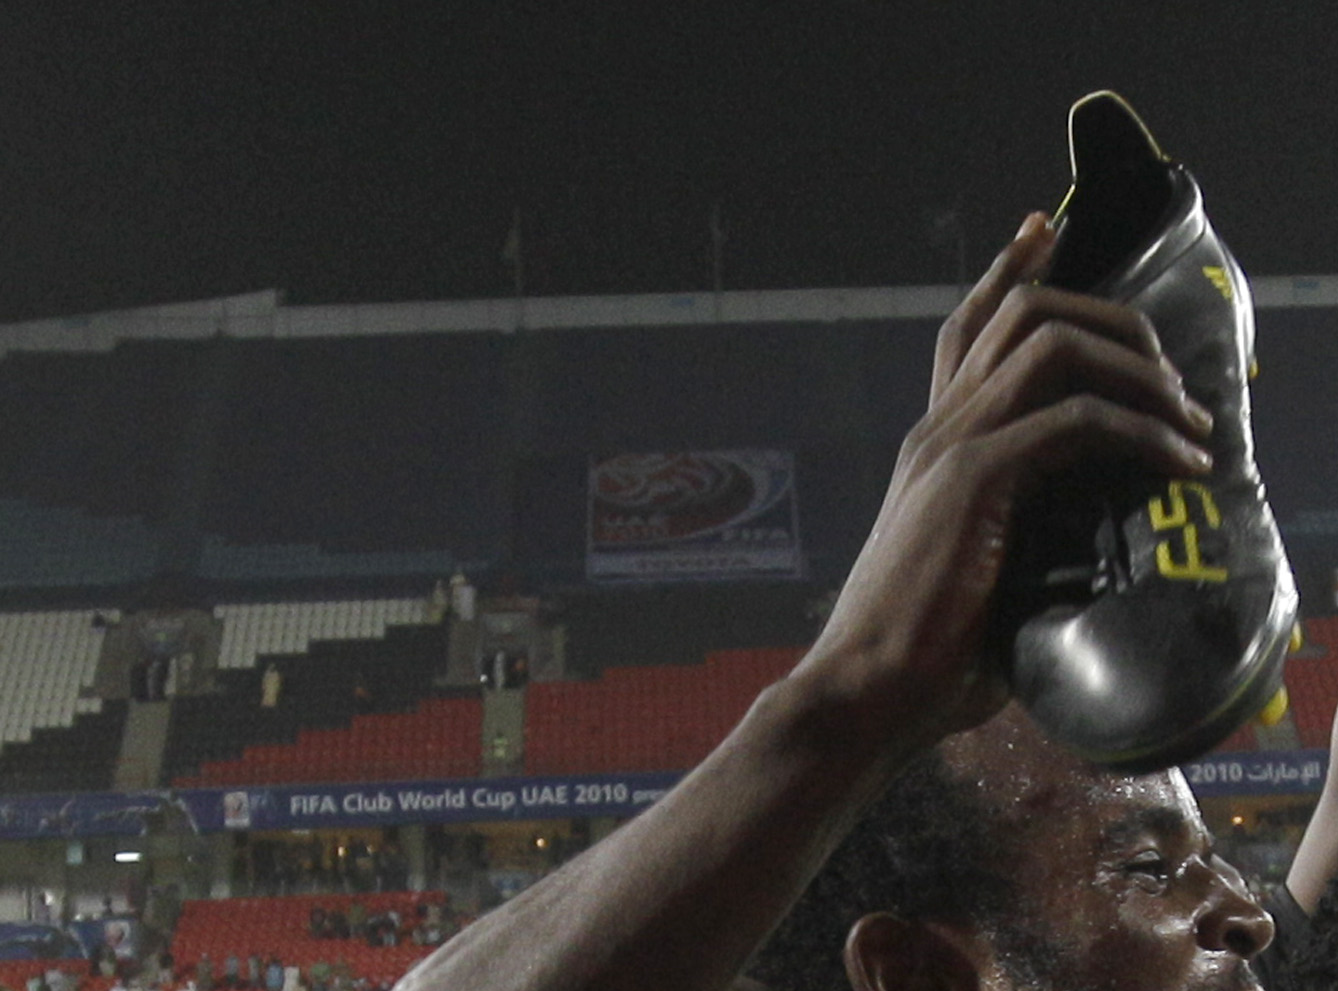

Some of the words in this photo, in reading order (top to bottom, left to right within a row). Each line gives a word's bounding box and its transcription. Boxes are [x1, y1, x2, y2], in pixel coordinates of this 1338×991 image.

[1190, 762, 1243, 783] 2010
[290, 794, 337, 816] FIFA
[343, 792, 392, 813] Club
[398, 788, 466, 811] World
[472, 787, 516, 812] Cup
[521, 785, 569, 807] UAE
[574, 783, 628, 804] 2010
